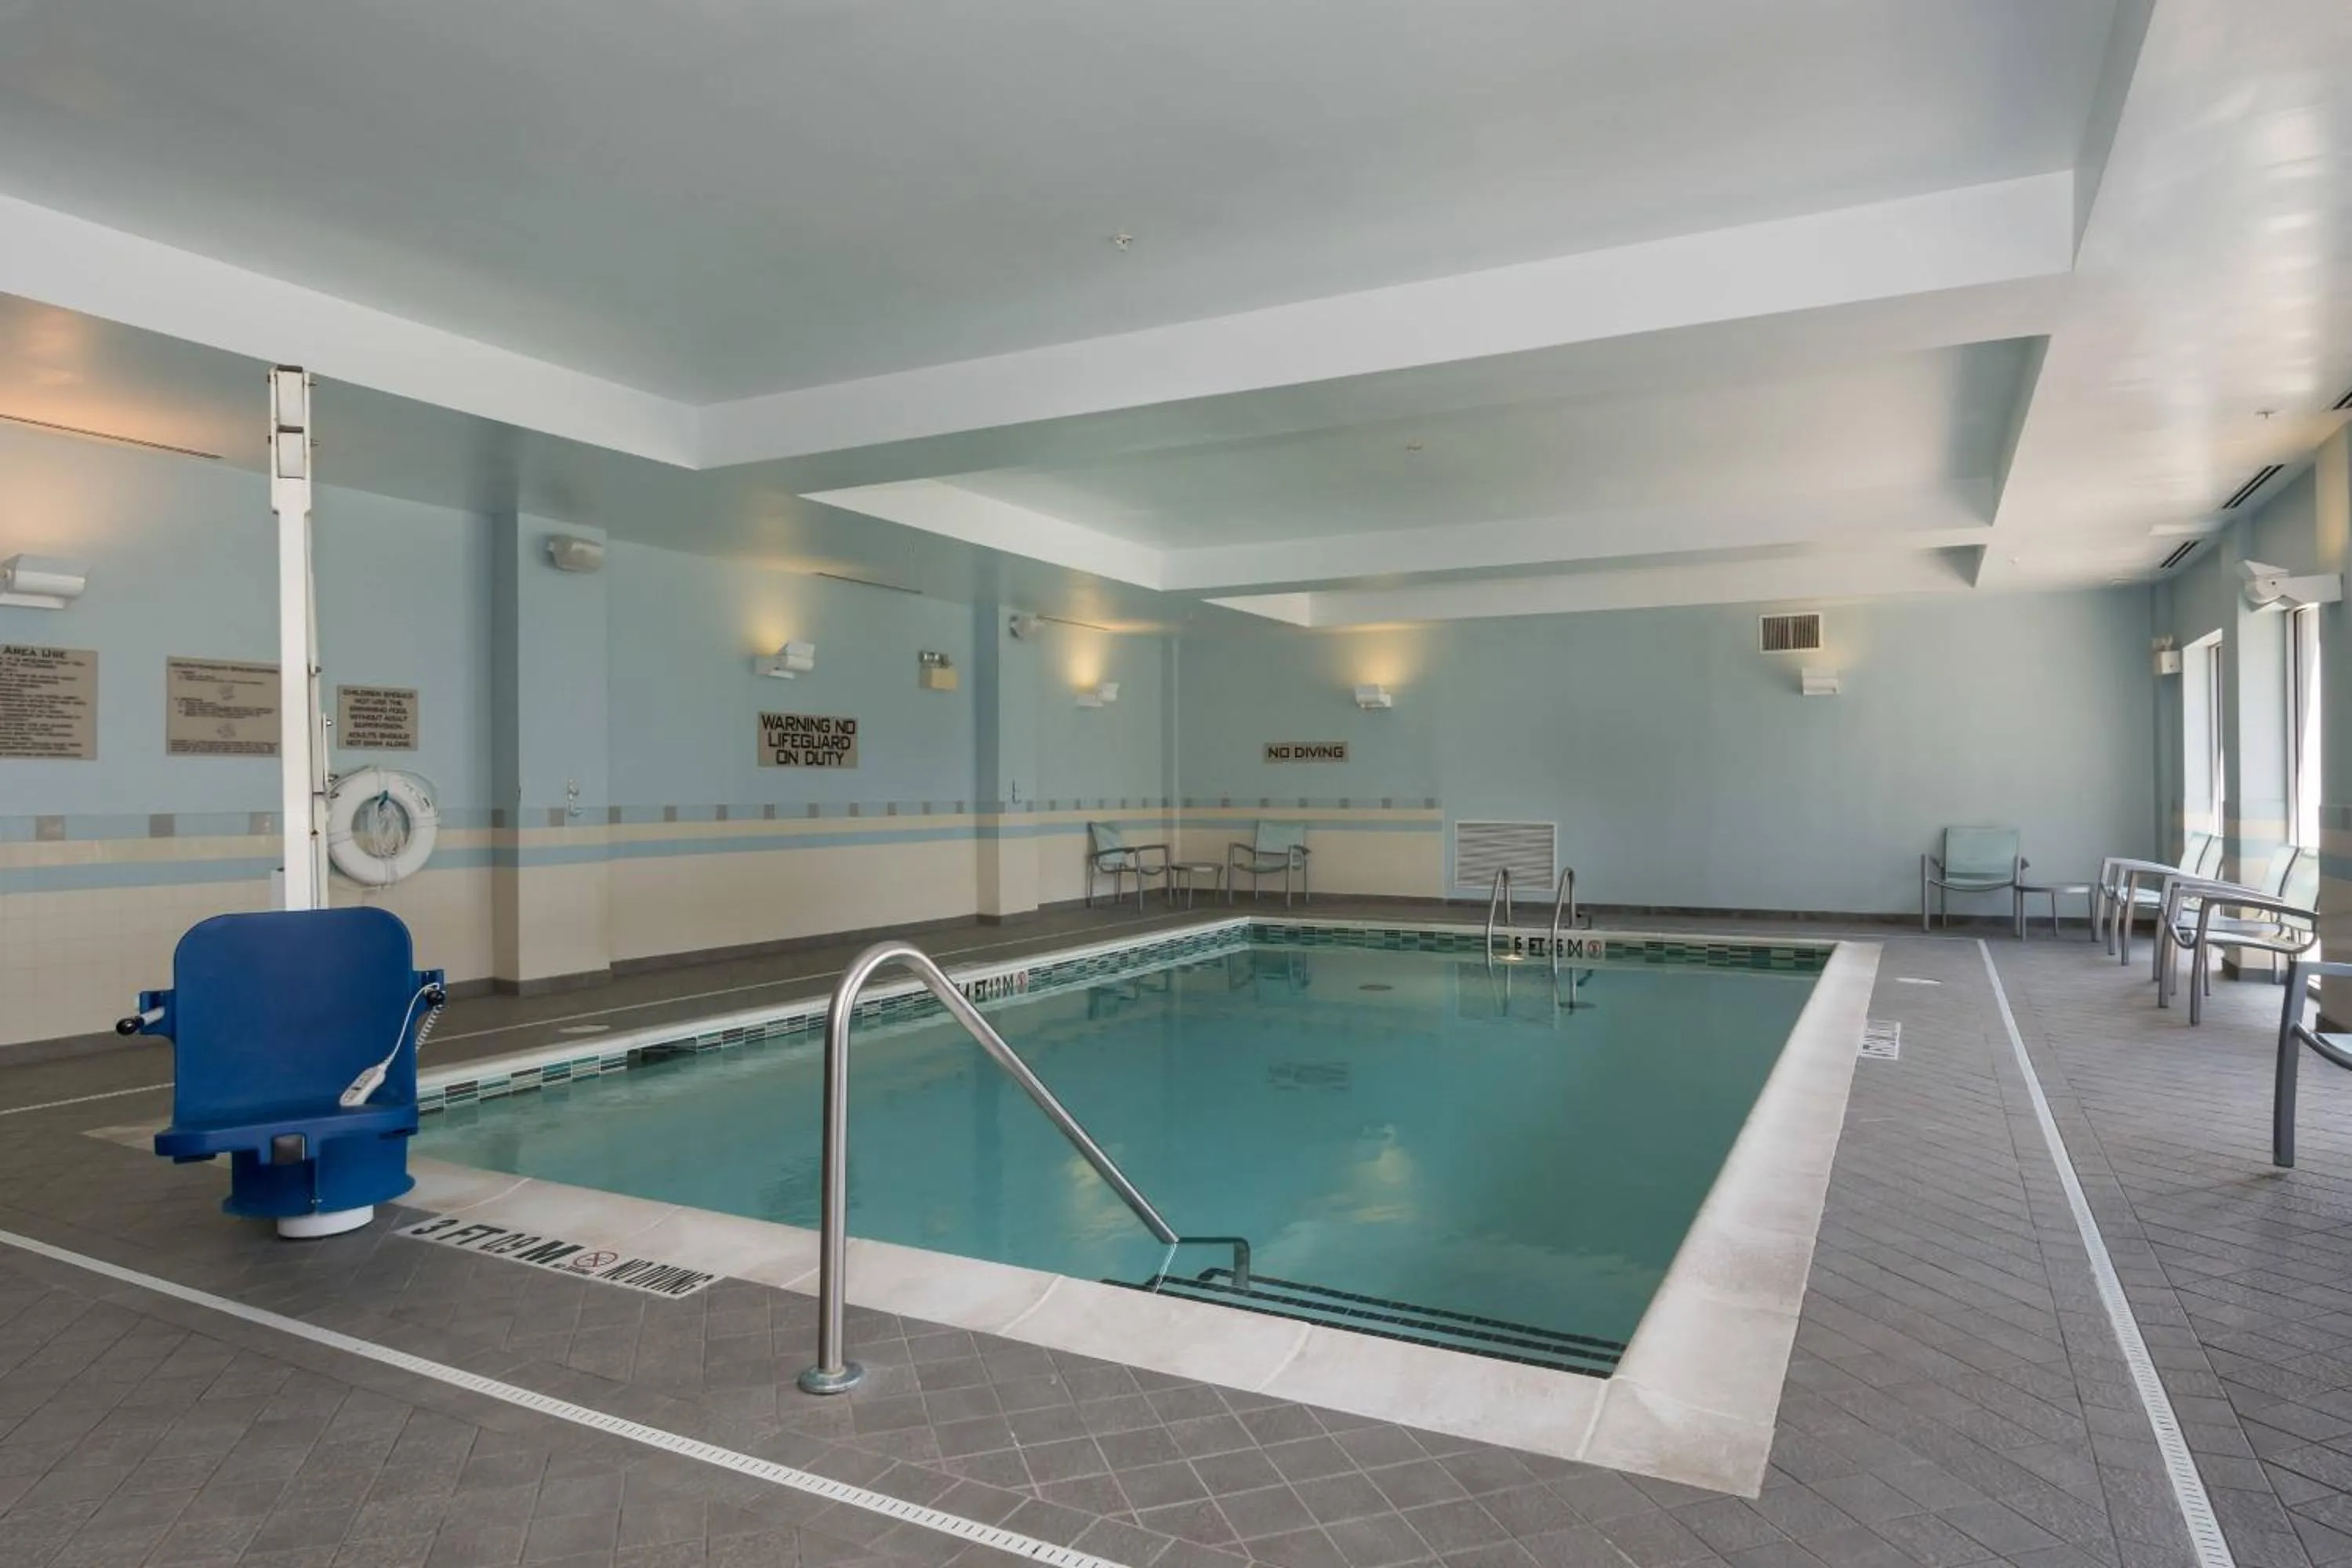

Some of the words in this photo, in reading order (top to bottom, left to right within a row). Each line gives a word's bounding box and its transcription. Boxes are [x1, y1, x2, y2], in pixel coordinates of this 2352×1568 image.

[761, 714, 830, 734] WARNING
[835, 719, 856, 735] NO
[768, 731, 851, 750] LIFEGUARD
[776, 750, 799, 765] ON
[804, 750, 844, 766] DUTY
[1268, 746, 1290, 759] NO
[1294, 746, 1344, 759] DIVING
[411, 1219, 459, 1236] 3
[435, 1224, 508, 1246] FT
[514, 1240, 585, 1264] M
[624, 1265, 714, 1294] DIVING
